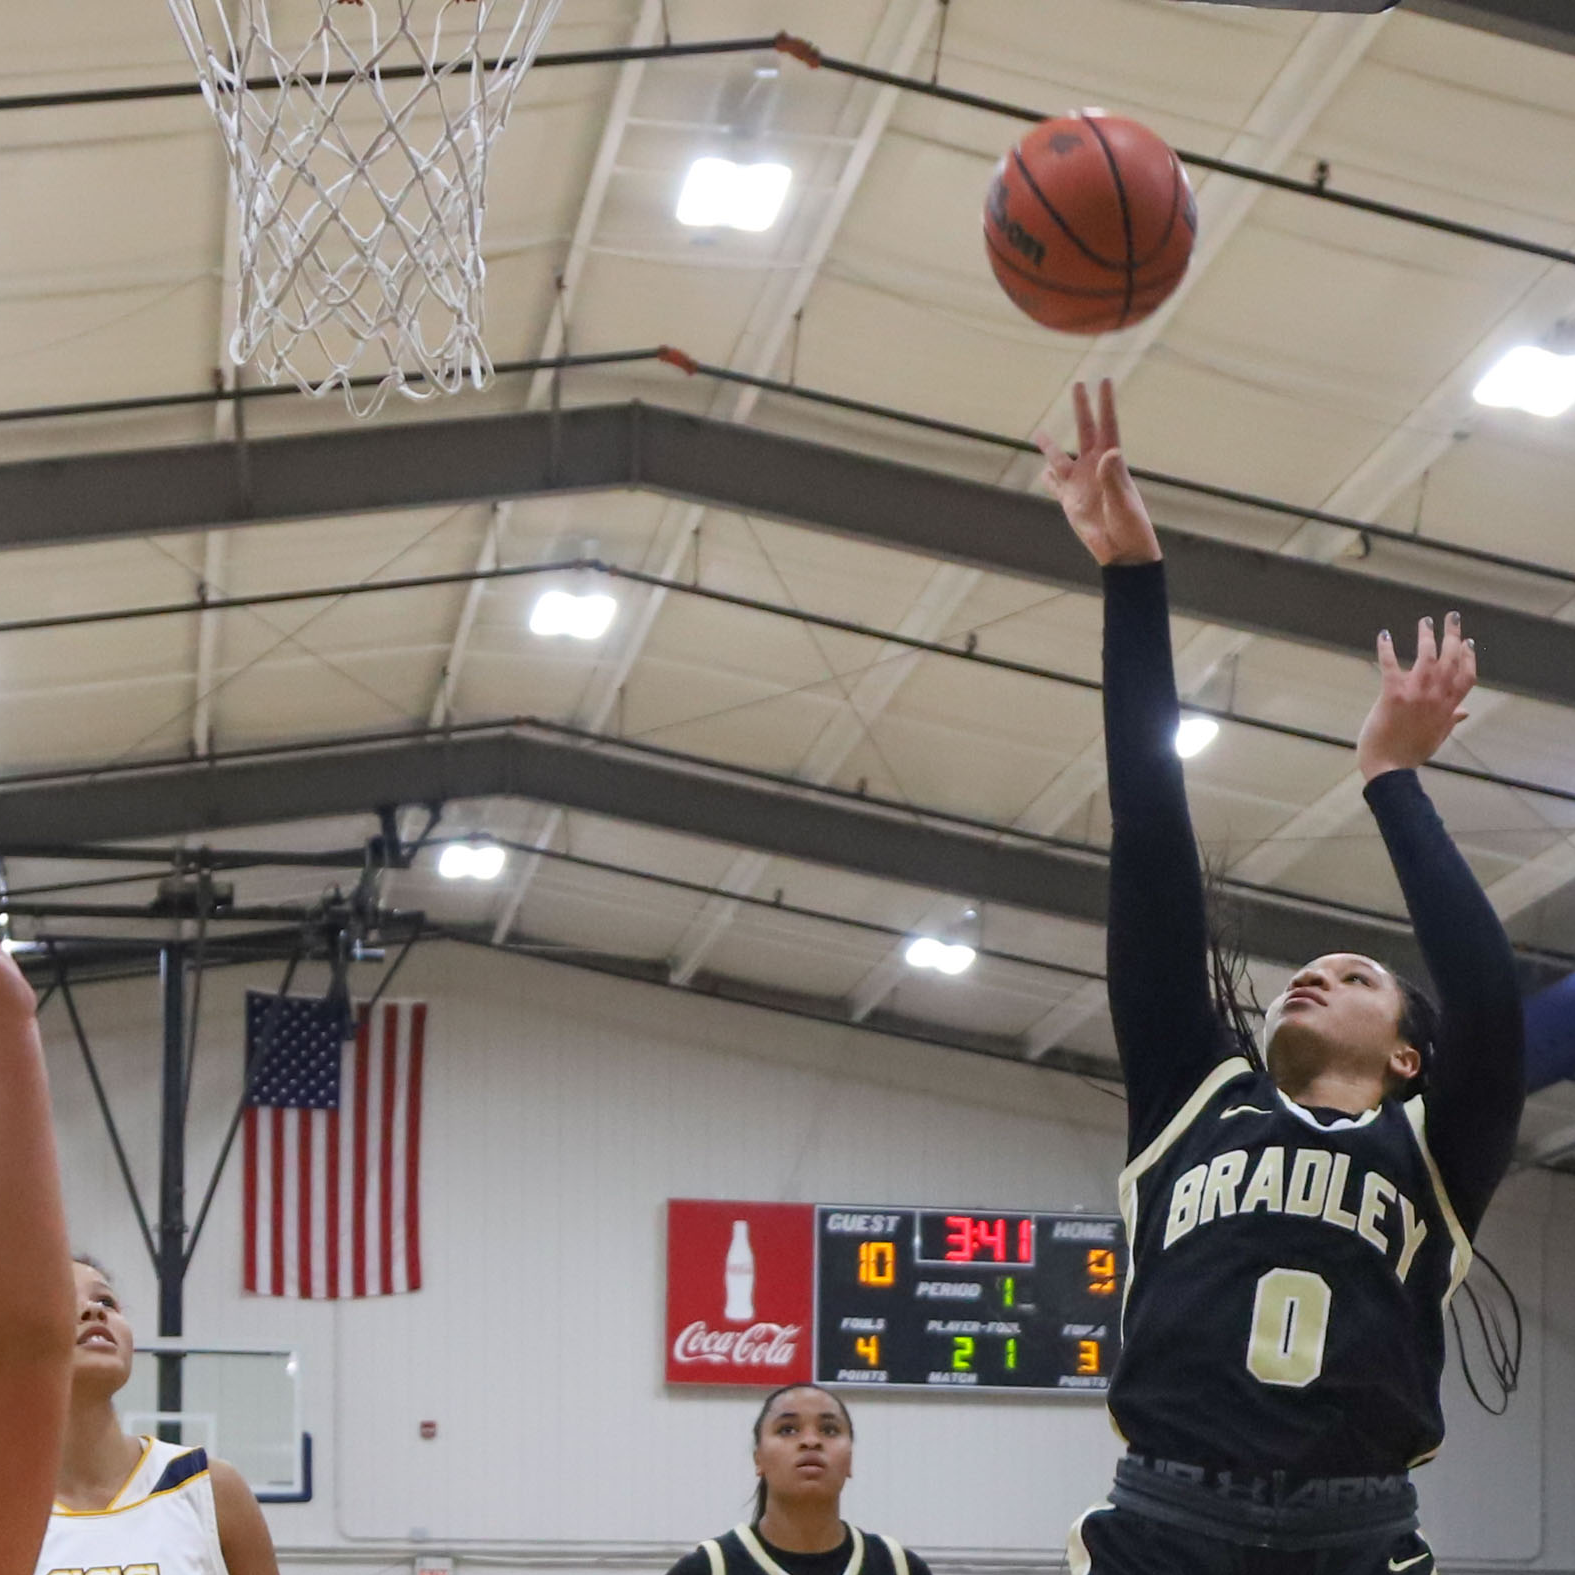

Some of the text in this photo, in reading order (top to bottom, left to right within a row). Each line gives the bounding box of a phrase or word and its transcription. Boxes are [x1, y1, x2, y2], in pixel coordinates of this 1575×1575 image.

[826, 1213, 1117, 1263] GUEST 3:41 HOME
[1163, 1146, 1427, 1284] BRADLEY
[858, 1240, 1116, 1294] 10 9
[916, 1276, 1015, 1308] PERIOD 1
[1246, 1267, 1332, 1388] 0
[855, 1334, 880, 1367] 4
[1077, 1340, 1100, 1374] 3
